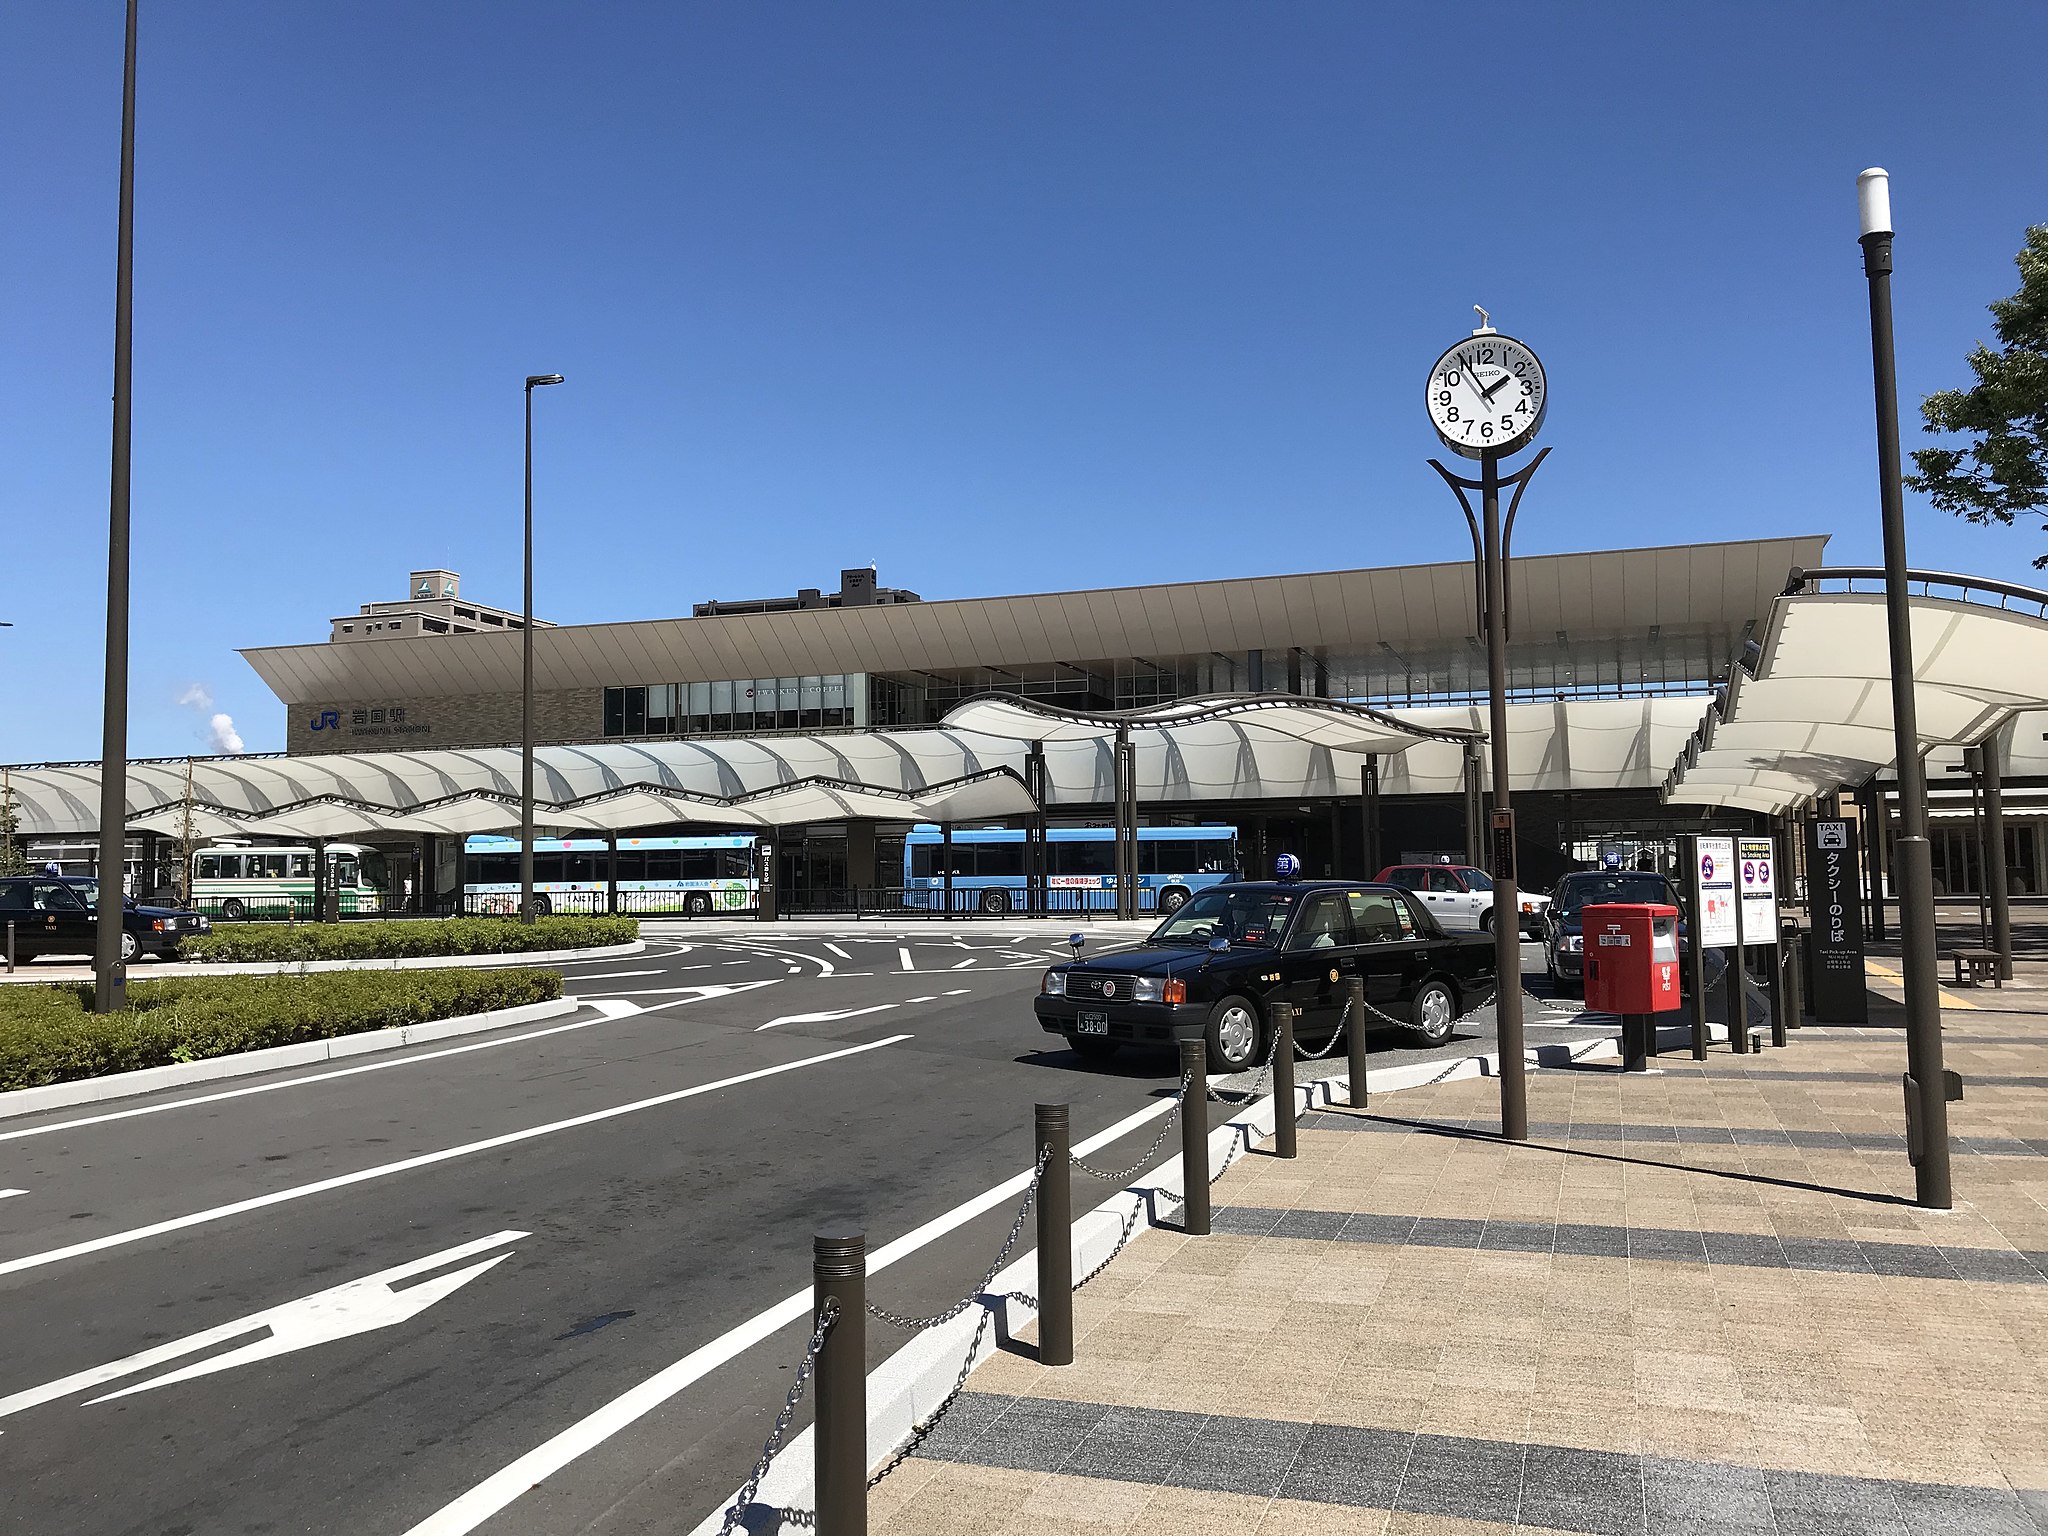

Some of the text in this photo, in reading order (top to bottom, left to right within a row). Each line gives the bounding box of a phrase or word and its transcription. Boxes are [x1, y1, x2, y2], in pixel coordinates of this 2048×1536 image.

[1477, 349, 1494, 365] 12
[1503, 350, 1508, 366] 1
[1514, 361, 1526, 378] 2
[1443, 371, 1460, 387] 10
[1520, 380, 1533, 396] 3
[1440, 390, 1451, 406] 9
[1447, 407, 1459, 422] 8
[1515, 399, 1528, 414] 4
[1463, 420, 1474, 435] 7
[1481, 422, 1493, 438] 6
[1501, 414, 1513, 430] 5
[310, 711, 339, 730] JR
[352, 708, 405, 724] 岩国駅
[1819, 823, 1843, 831] TAXI
[1827, 852, 1844, 942] タクシーのりば
[1084, 1020, 1106, 1033] 38-00
